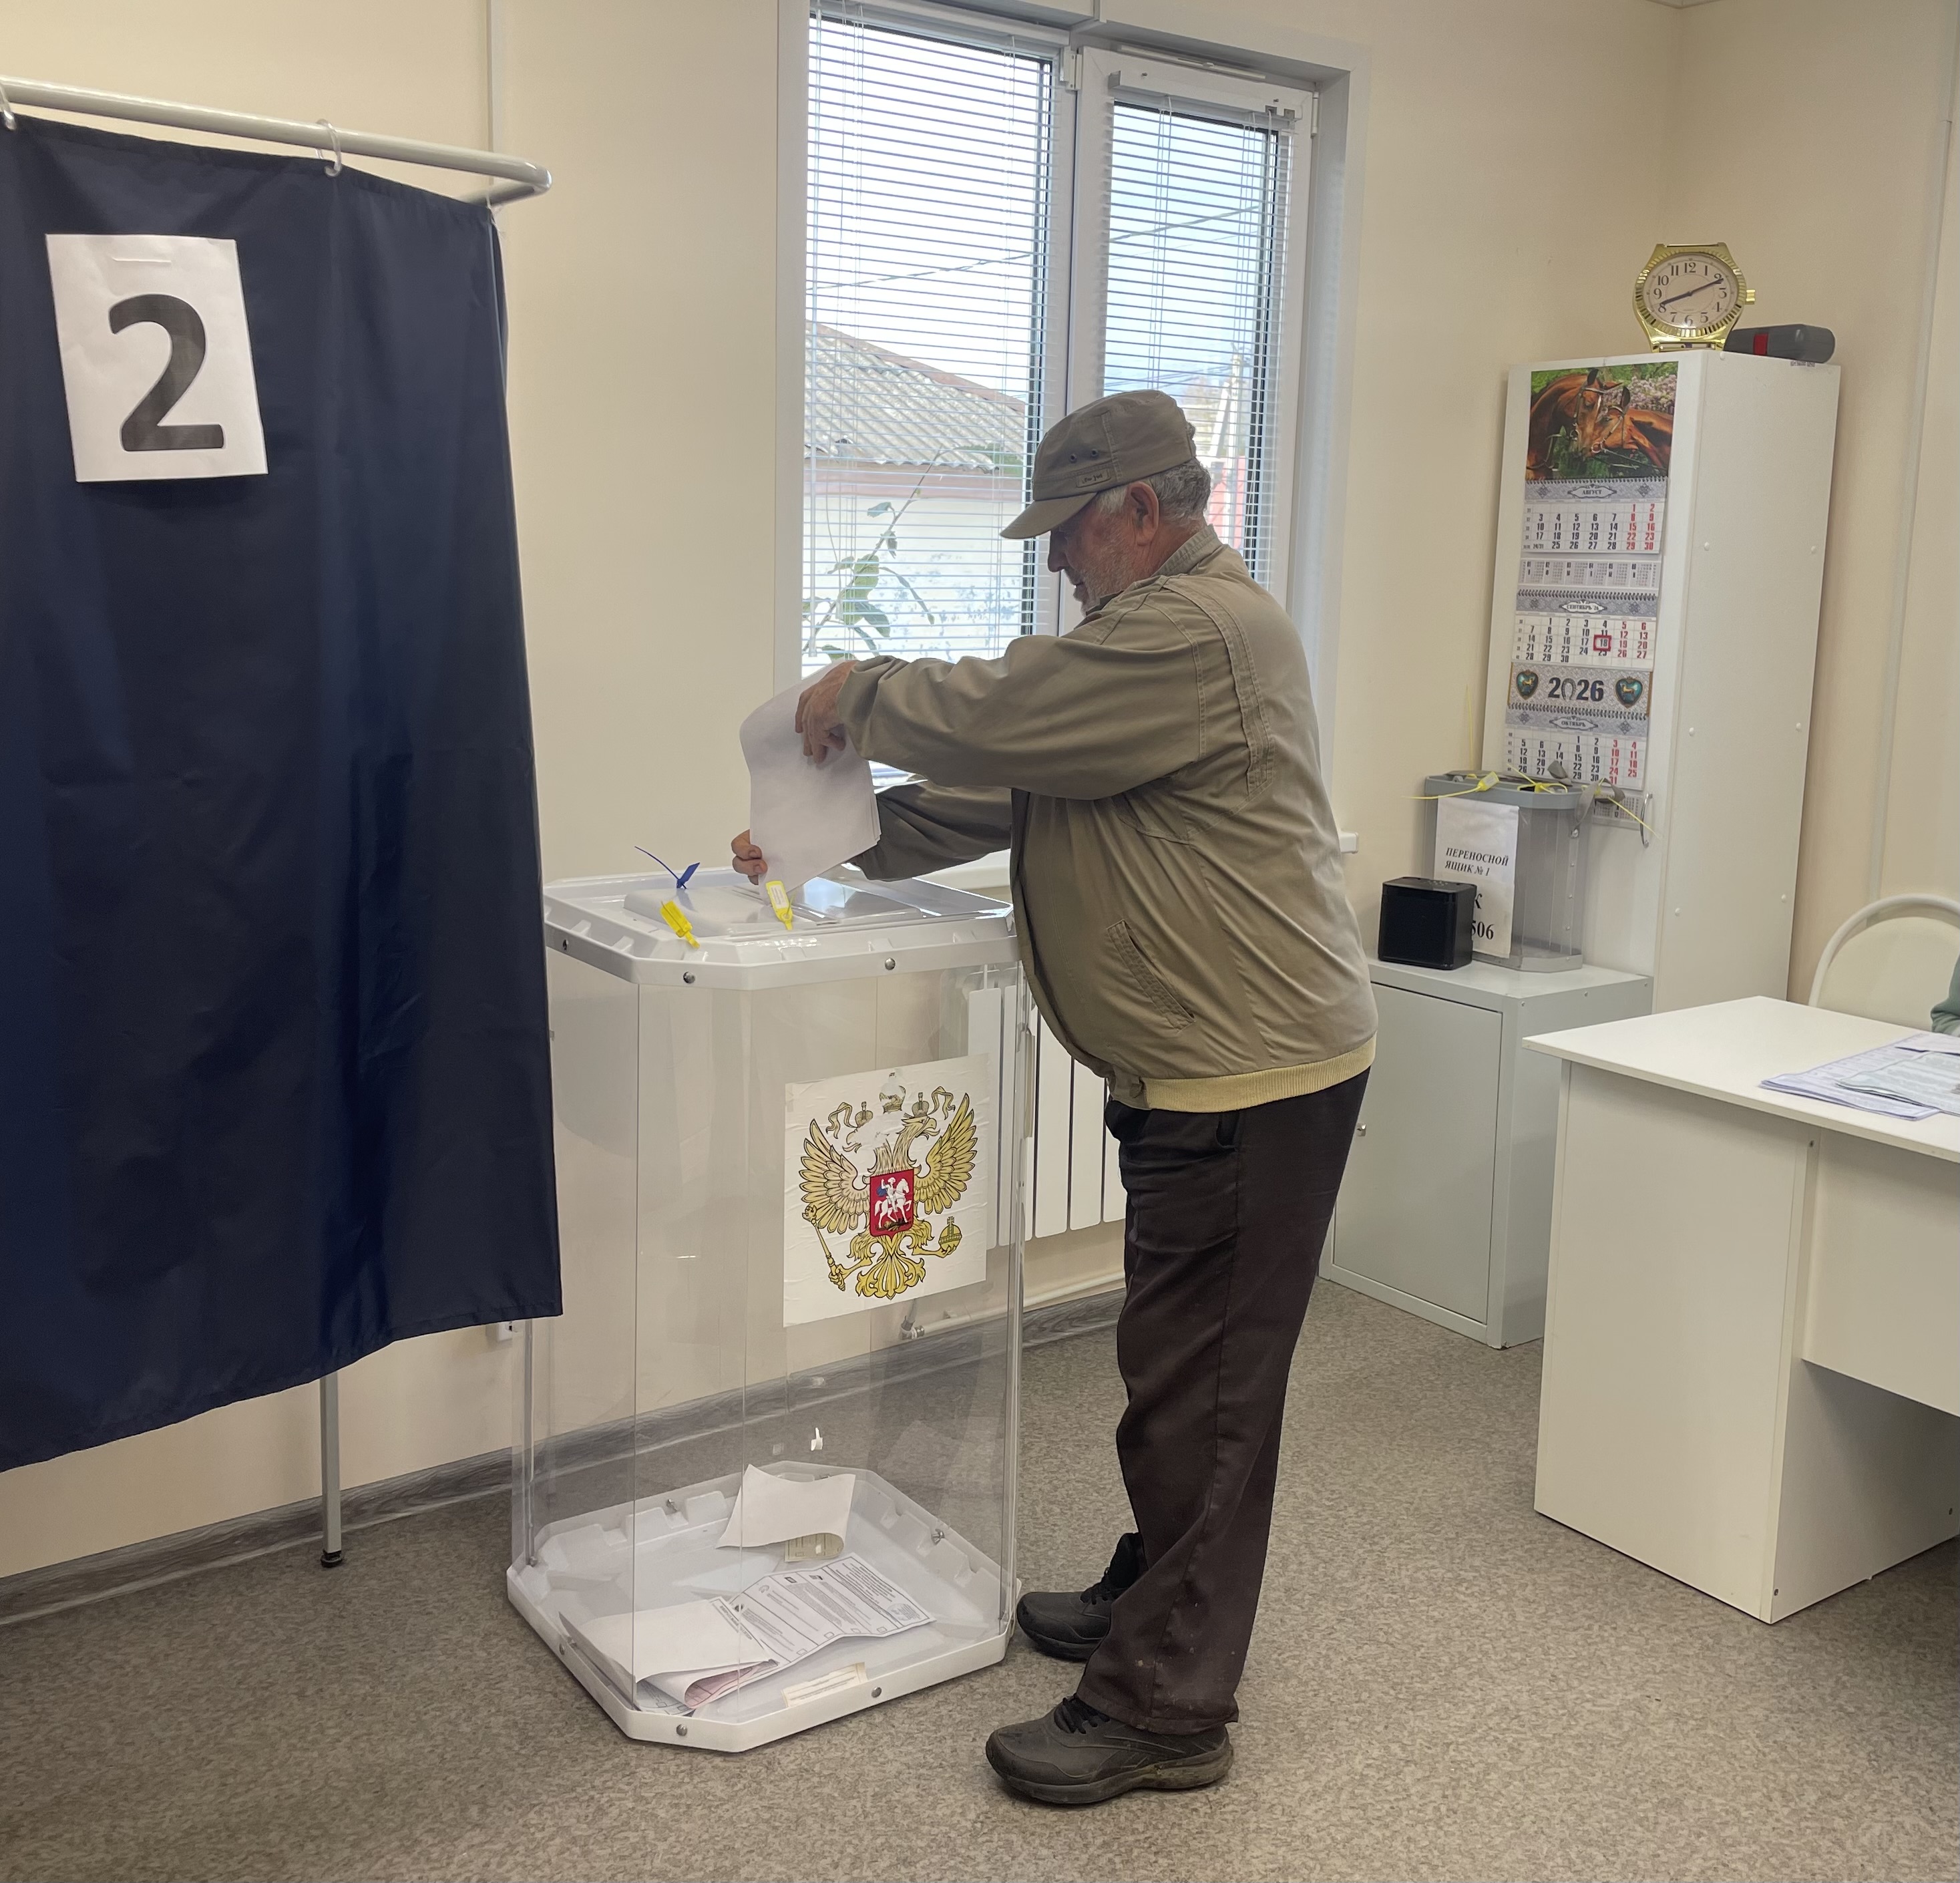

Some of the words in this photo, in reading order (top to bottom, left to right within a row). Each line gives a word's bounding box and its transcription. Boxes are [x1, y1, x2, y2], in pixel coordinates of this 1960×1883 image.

[1671, 265, 1679, 276] 11
[1684, 263, 1696, 273] 12
[1705, 266, 1708, 276] 1
[1657, 275, 1669, 285] 10
[1714, 274, 1724, 284] 2
[1653, 289, 1662, 299] 9
[1719, 288, 1727, 299] 3
[1658, 303, 1666, 313] 8
[1712, 302, 1722, 312] 4
[1670, 312, 1677, 323] 7
[1685, 315, 1693, 327] 6
[1701, 312, 1708, 323] 5
[109, 294, 224, 452] 2
[1557, 514, 1561, 522] 4
[1537, 523, 1544, 531] 10
[1555, 523, 1561, 531] 11
[1573, 523, 1580, 531] 12
[1591, 523, 1599, 531] 13
[1610, 523, 1617, 531] 14
[1647, 523, 1655, 531] 16
[1627, 532, 1636, 540] 22
[1645, 532, 1654, 540] 23
[1607, 542, 1617, 550] 28
[1626, 542, 1635, 550] 29
[1584, 619, 1588, 627] 3
[1531, 625, 1535, 633] 7
[1639, 632, 1647, 640] 13
[1529, 635, 1535, 643] 14
[1561, 655, 1569, 663] 30
[1617, 649, 1627, 657] 26
[1637, 651, 1647, 659] 27
[1613, 739, 1617, 747] 3
[1631, 741, 1636, 749] 4
[1558, 743, 1561, 751] 7
[1611, 749, 1619, 757] 10
[1630, 751, 1637, 759] 11
[1519, 765, 1527, 774] 26
[1537, 767, 1545, 776] 27
[1573, 772, 1581, 780] 29
[1591, 765, 1599, 773] 23
[1609, 767, 1618, 775] 24
[1628, 769, 1637, 778] 25
[1446, 848, 1509, 866] ПЕРЕНОСНОЙ
[1445, 860, 1474, 873] ЯЩИК
[1474, 866, 1483, 875] №
[1485, 868, 1490, 876] 1
